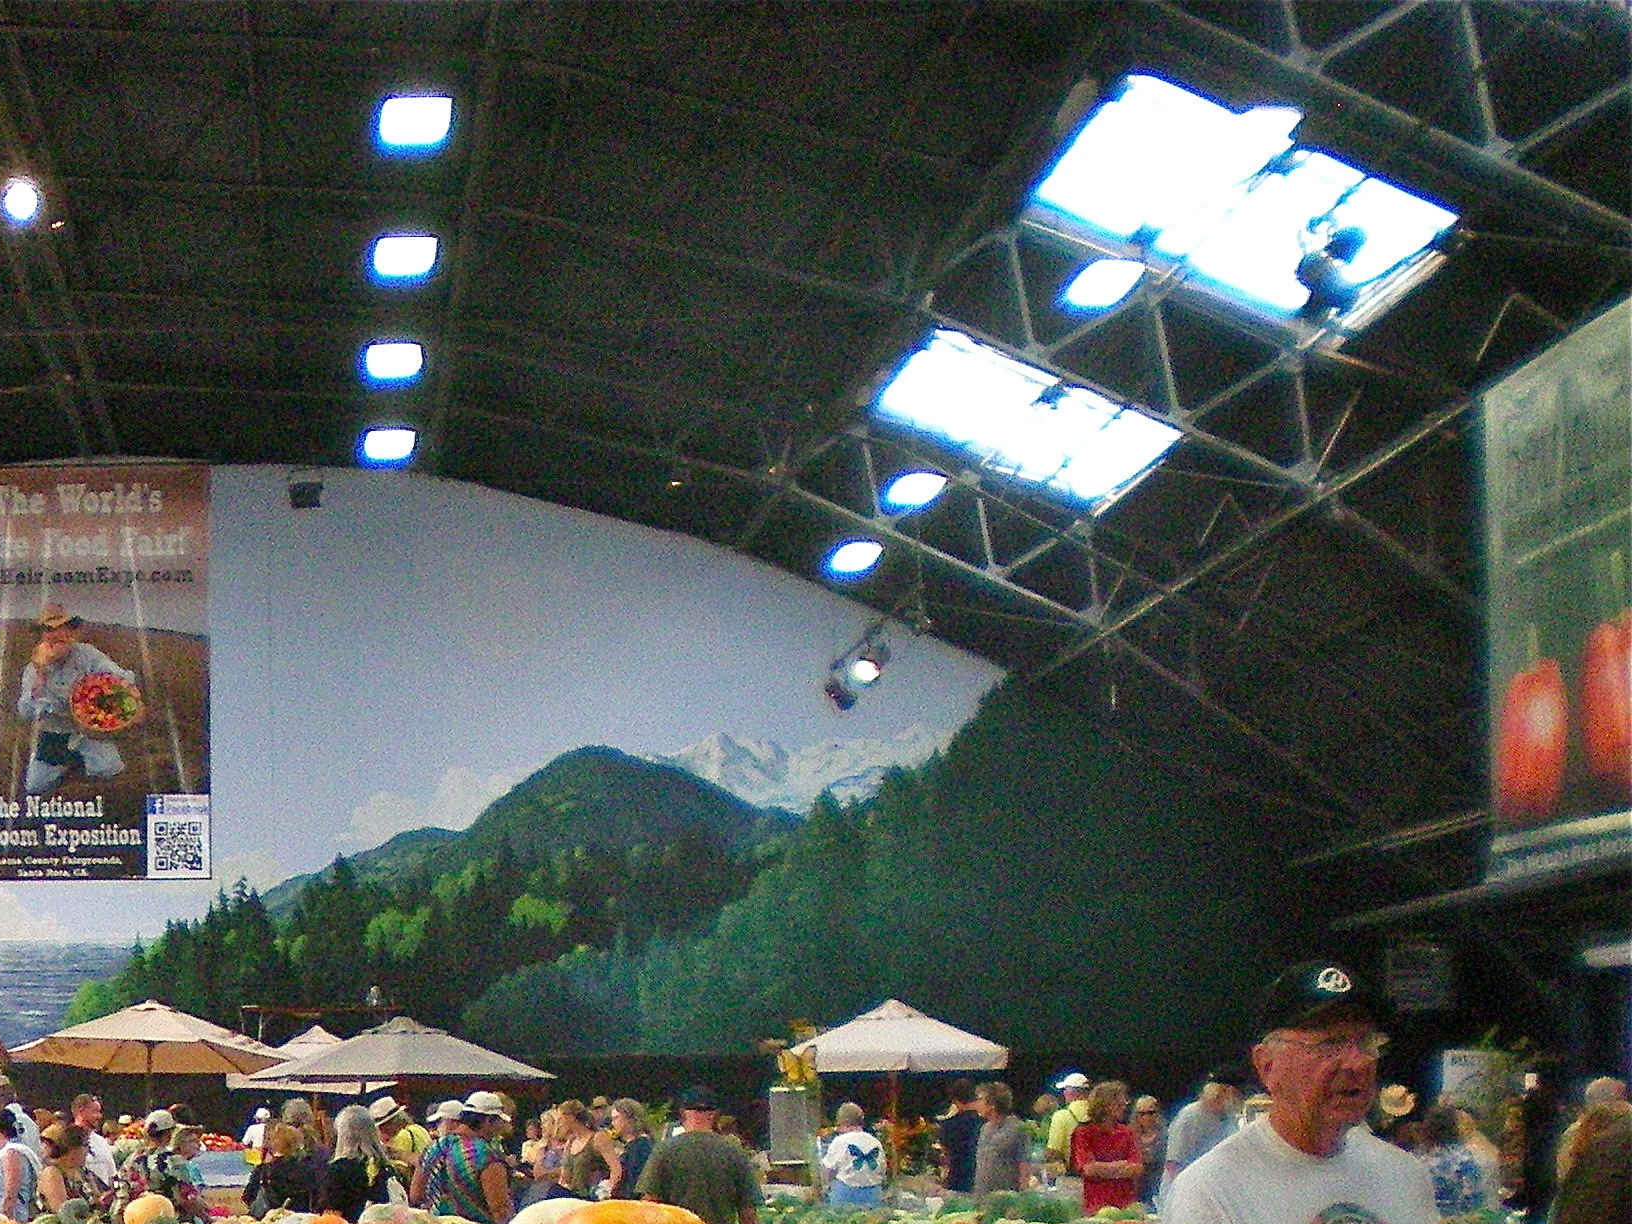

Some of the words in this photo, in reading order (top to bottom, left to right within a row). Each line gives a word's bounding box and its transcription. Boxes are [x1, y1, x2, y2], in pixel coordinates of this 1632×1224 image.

[57, 483, 162, 515] World's
[41, 527, 109, 559] Food
[26, 795, 104, 818] National
[44, 823, 142, 853] Exposition
[24, 856, 60, 867] County
